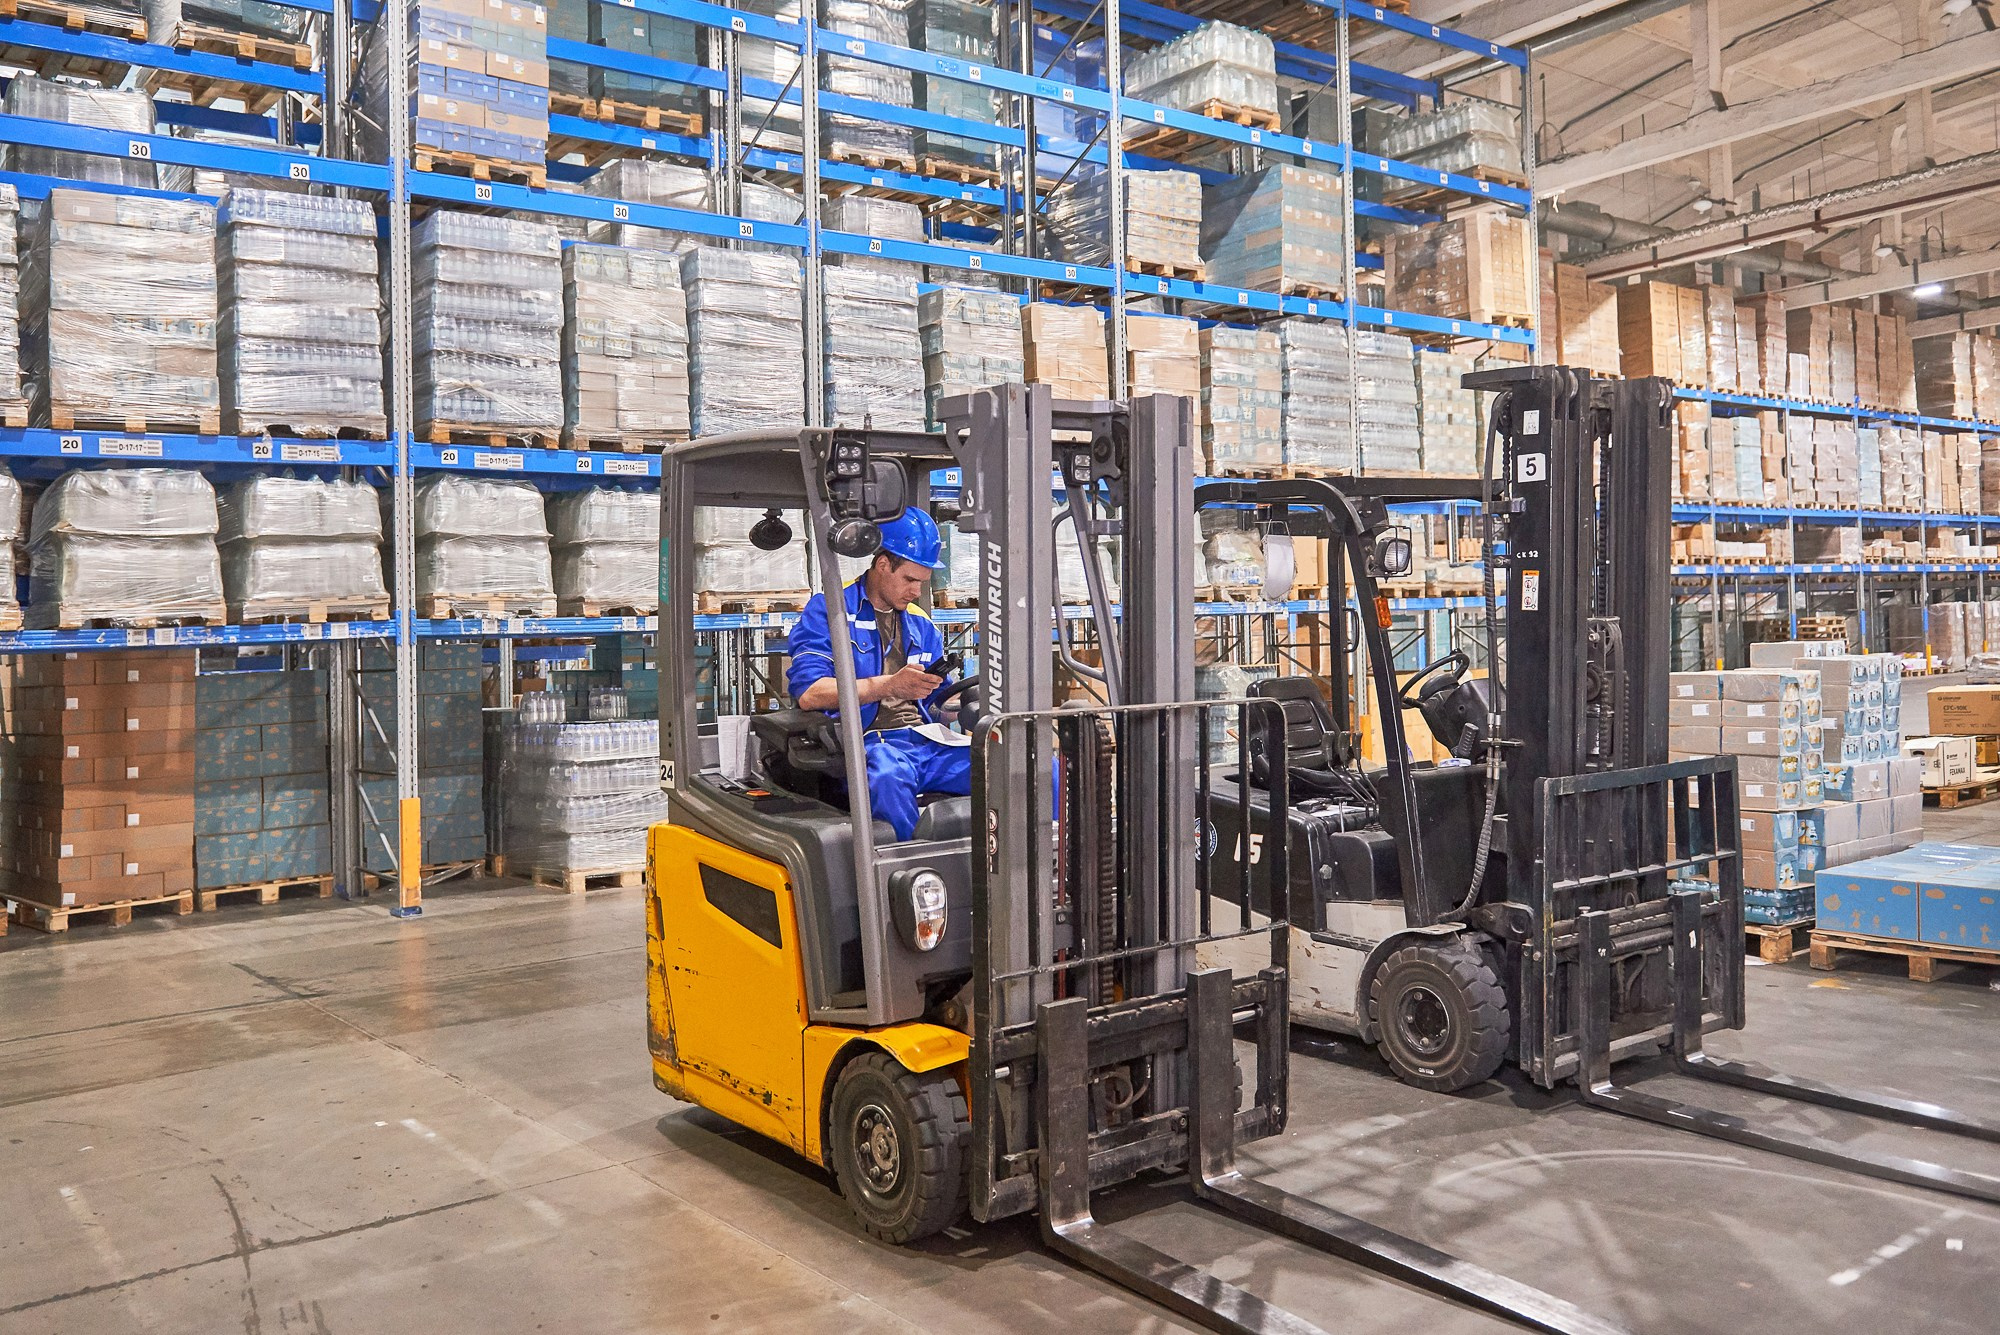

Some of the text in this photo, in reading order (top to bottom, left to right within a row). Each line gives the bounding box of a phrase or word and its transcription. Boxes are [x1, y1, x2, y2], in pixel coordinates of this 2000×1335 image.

[733, 20, 744, 28] 40
[131, 144, 148, 157] 30
[293, 166, 308, 178] 30
[477, 187, 490, 199] 30
[615, 207, 627, 218] 30
[741, 225, 752, 235] 30
[870, 241, 880, 251] 30
[971, 257, 981, 267] 30
[1066, 268, 1076, 278] 30
[1159, 283, 1167, 291] 30
[1240, 294, 1247, 302] 30
[1309, 305, 1316, 313] 30
[62, 440, 79, 449] 20
[118, 443, 143, 452] D-17-17
[254, 446, 269, 455] 20
[443, 453, 455, 461] 20
[578, 460, 590, 468] 20
[1525, 457, 1537, 477] 5
[660, 764, 674, 782] 24
